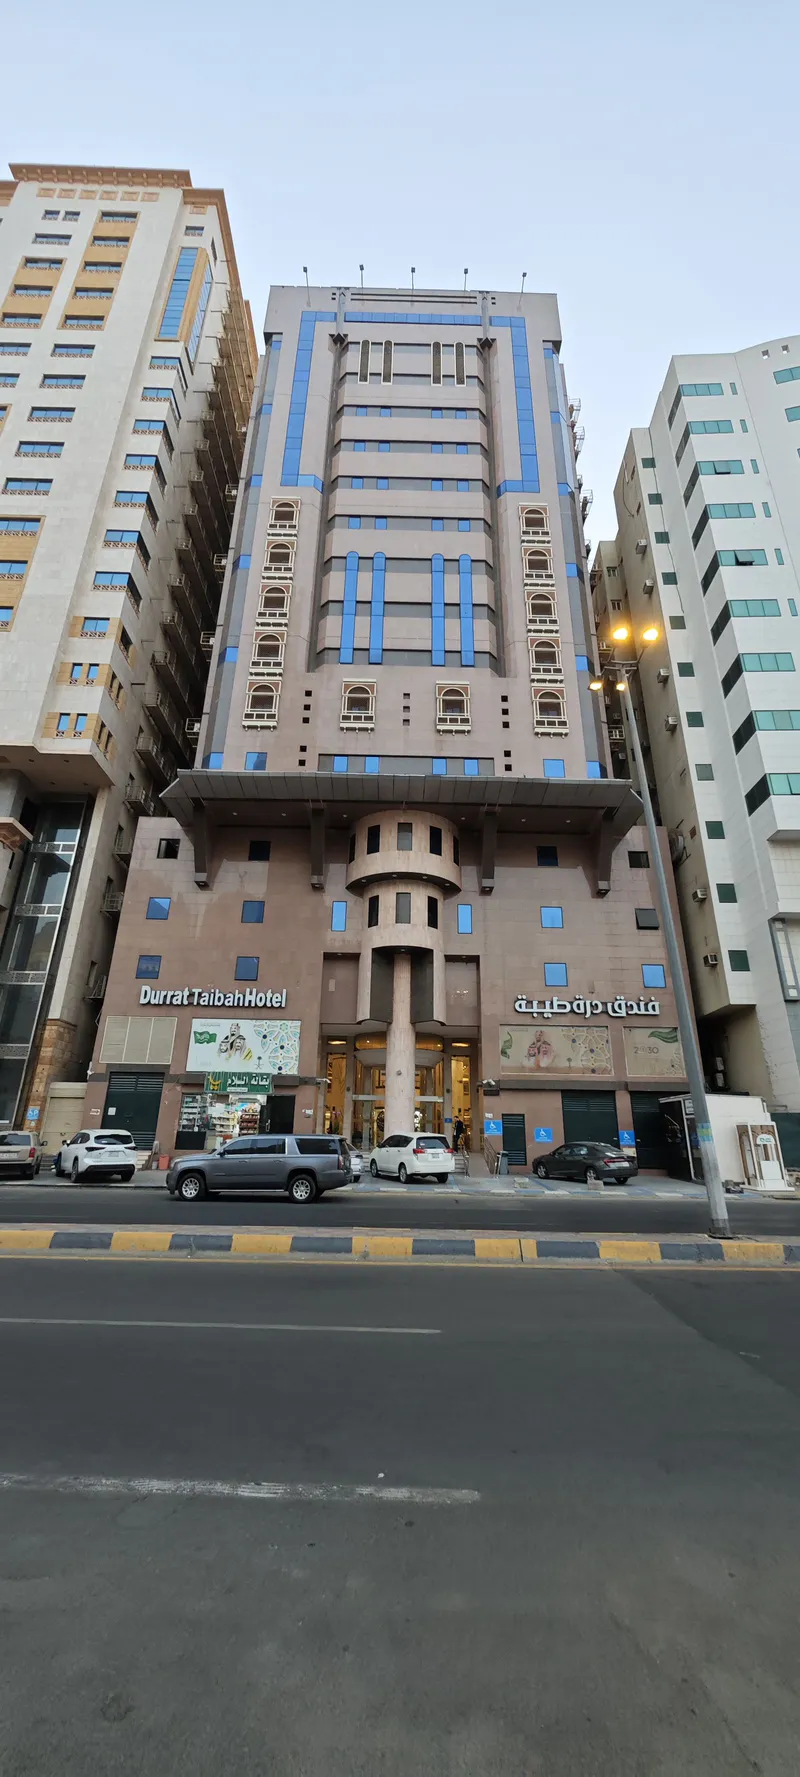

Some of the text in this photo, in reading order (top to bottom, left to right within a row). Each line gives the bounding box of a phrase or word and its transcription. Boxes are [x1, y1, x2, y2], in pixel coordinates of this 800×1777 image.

[139, 985, 189, 1005] Durrat
[514, 994, 660, 1018] فندق درة طيبة
[250, 1073, 270, 1088] بقالة
